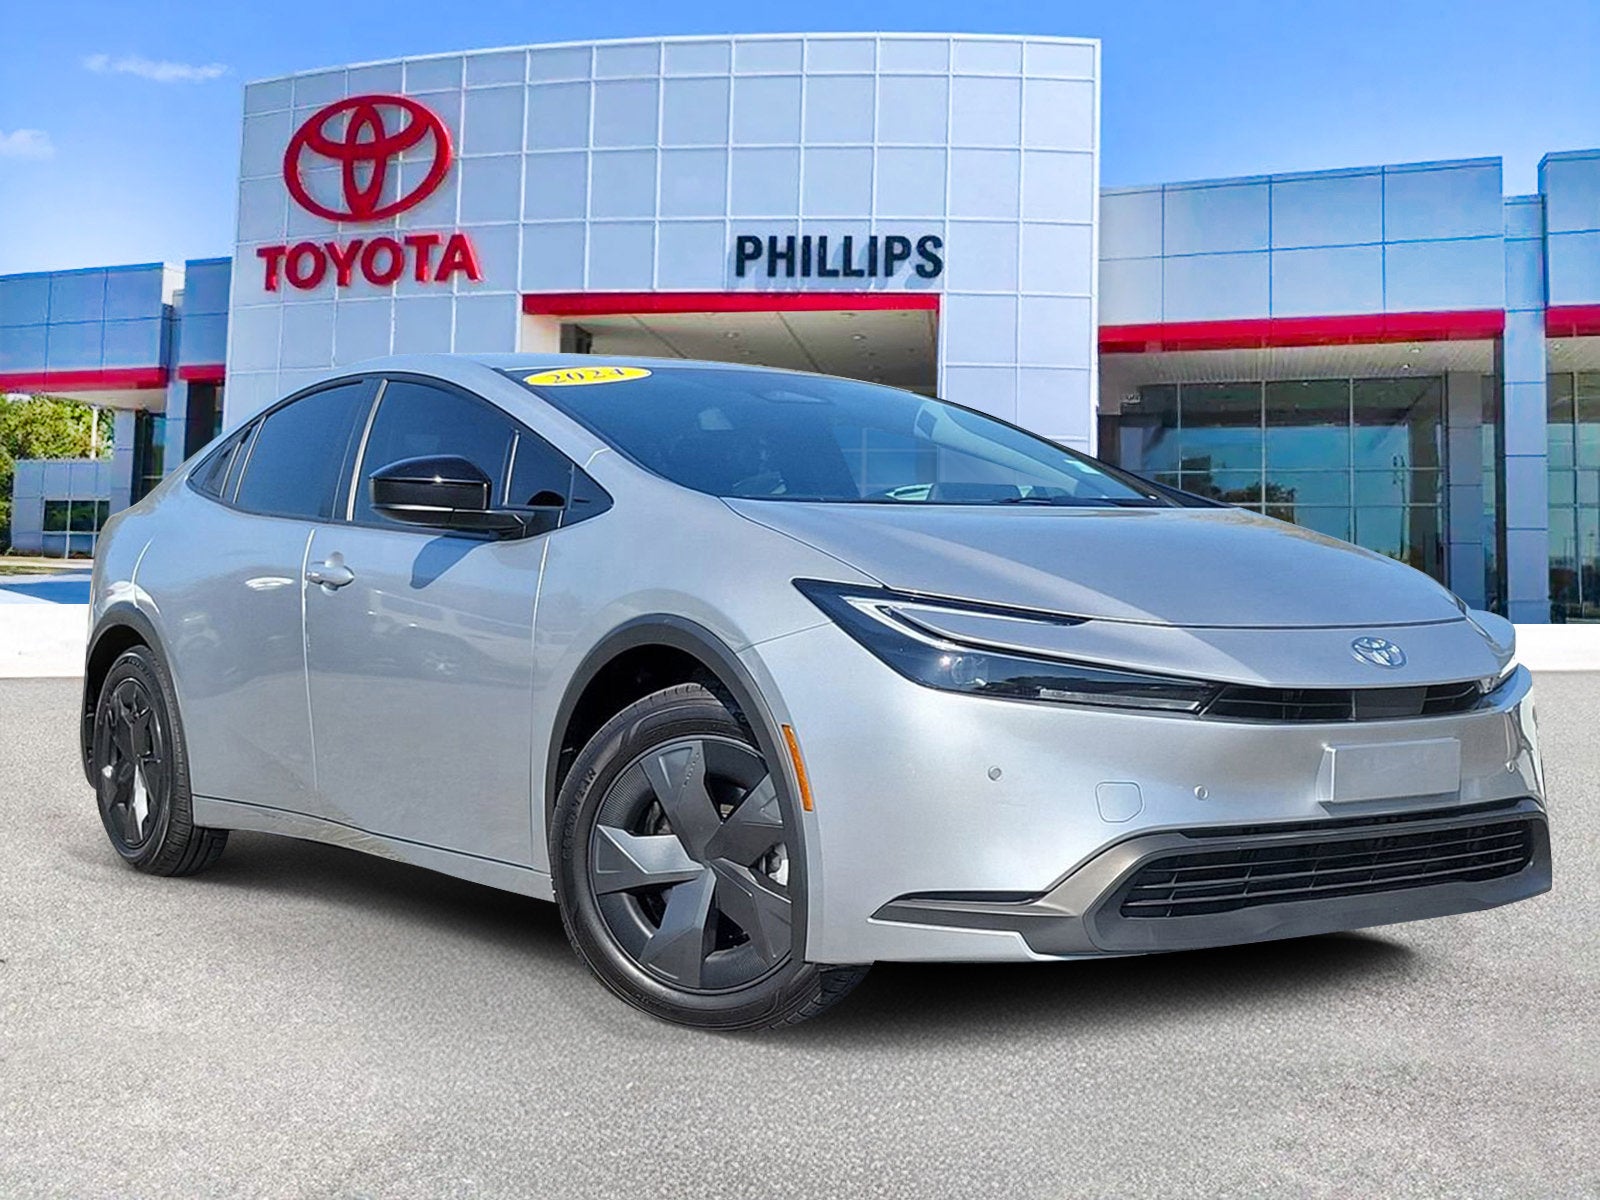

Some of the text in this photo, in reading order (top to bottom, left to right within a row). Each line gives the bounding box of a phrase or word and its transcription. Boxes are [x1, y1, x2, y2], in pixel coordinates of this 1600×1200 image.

[256, 233, 482, 292] TOYOTA
[735, 235, 944, 279] PHILLIPS
[548, 368, 625, 383] 2024
